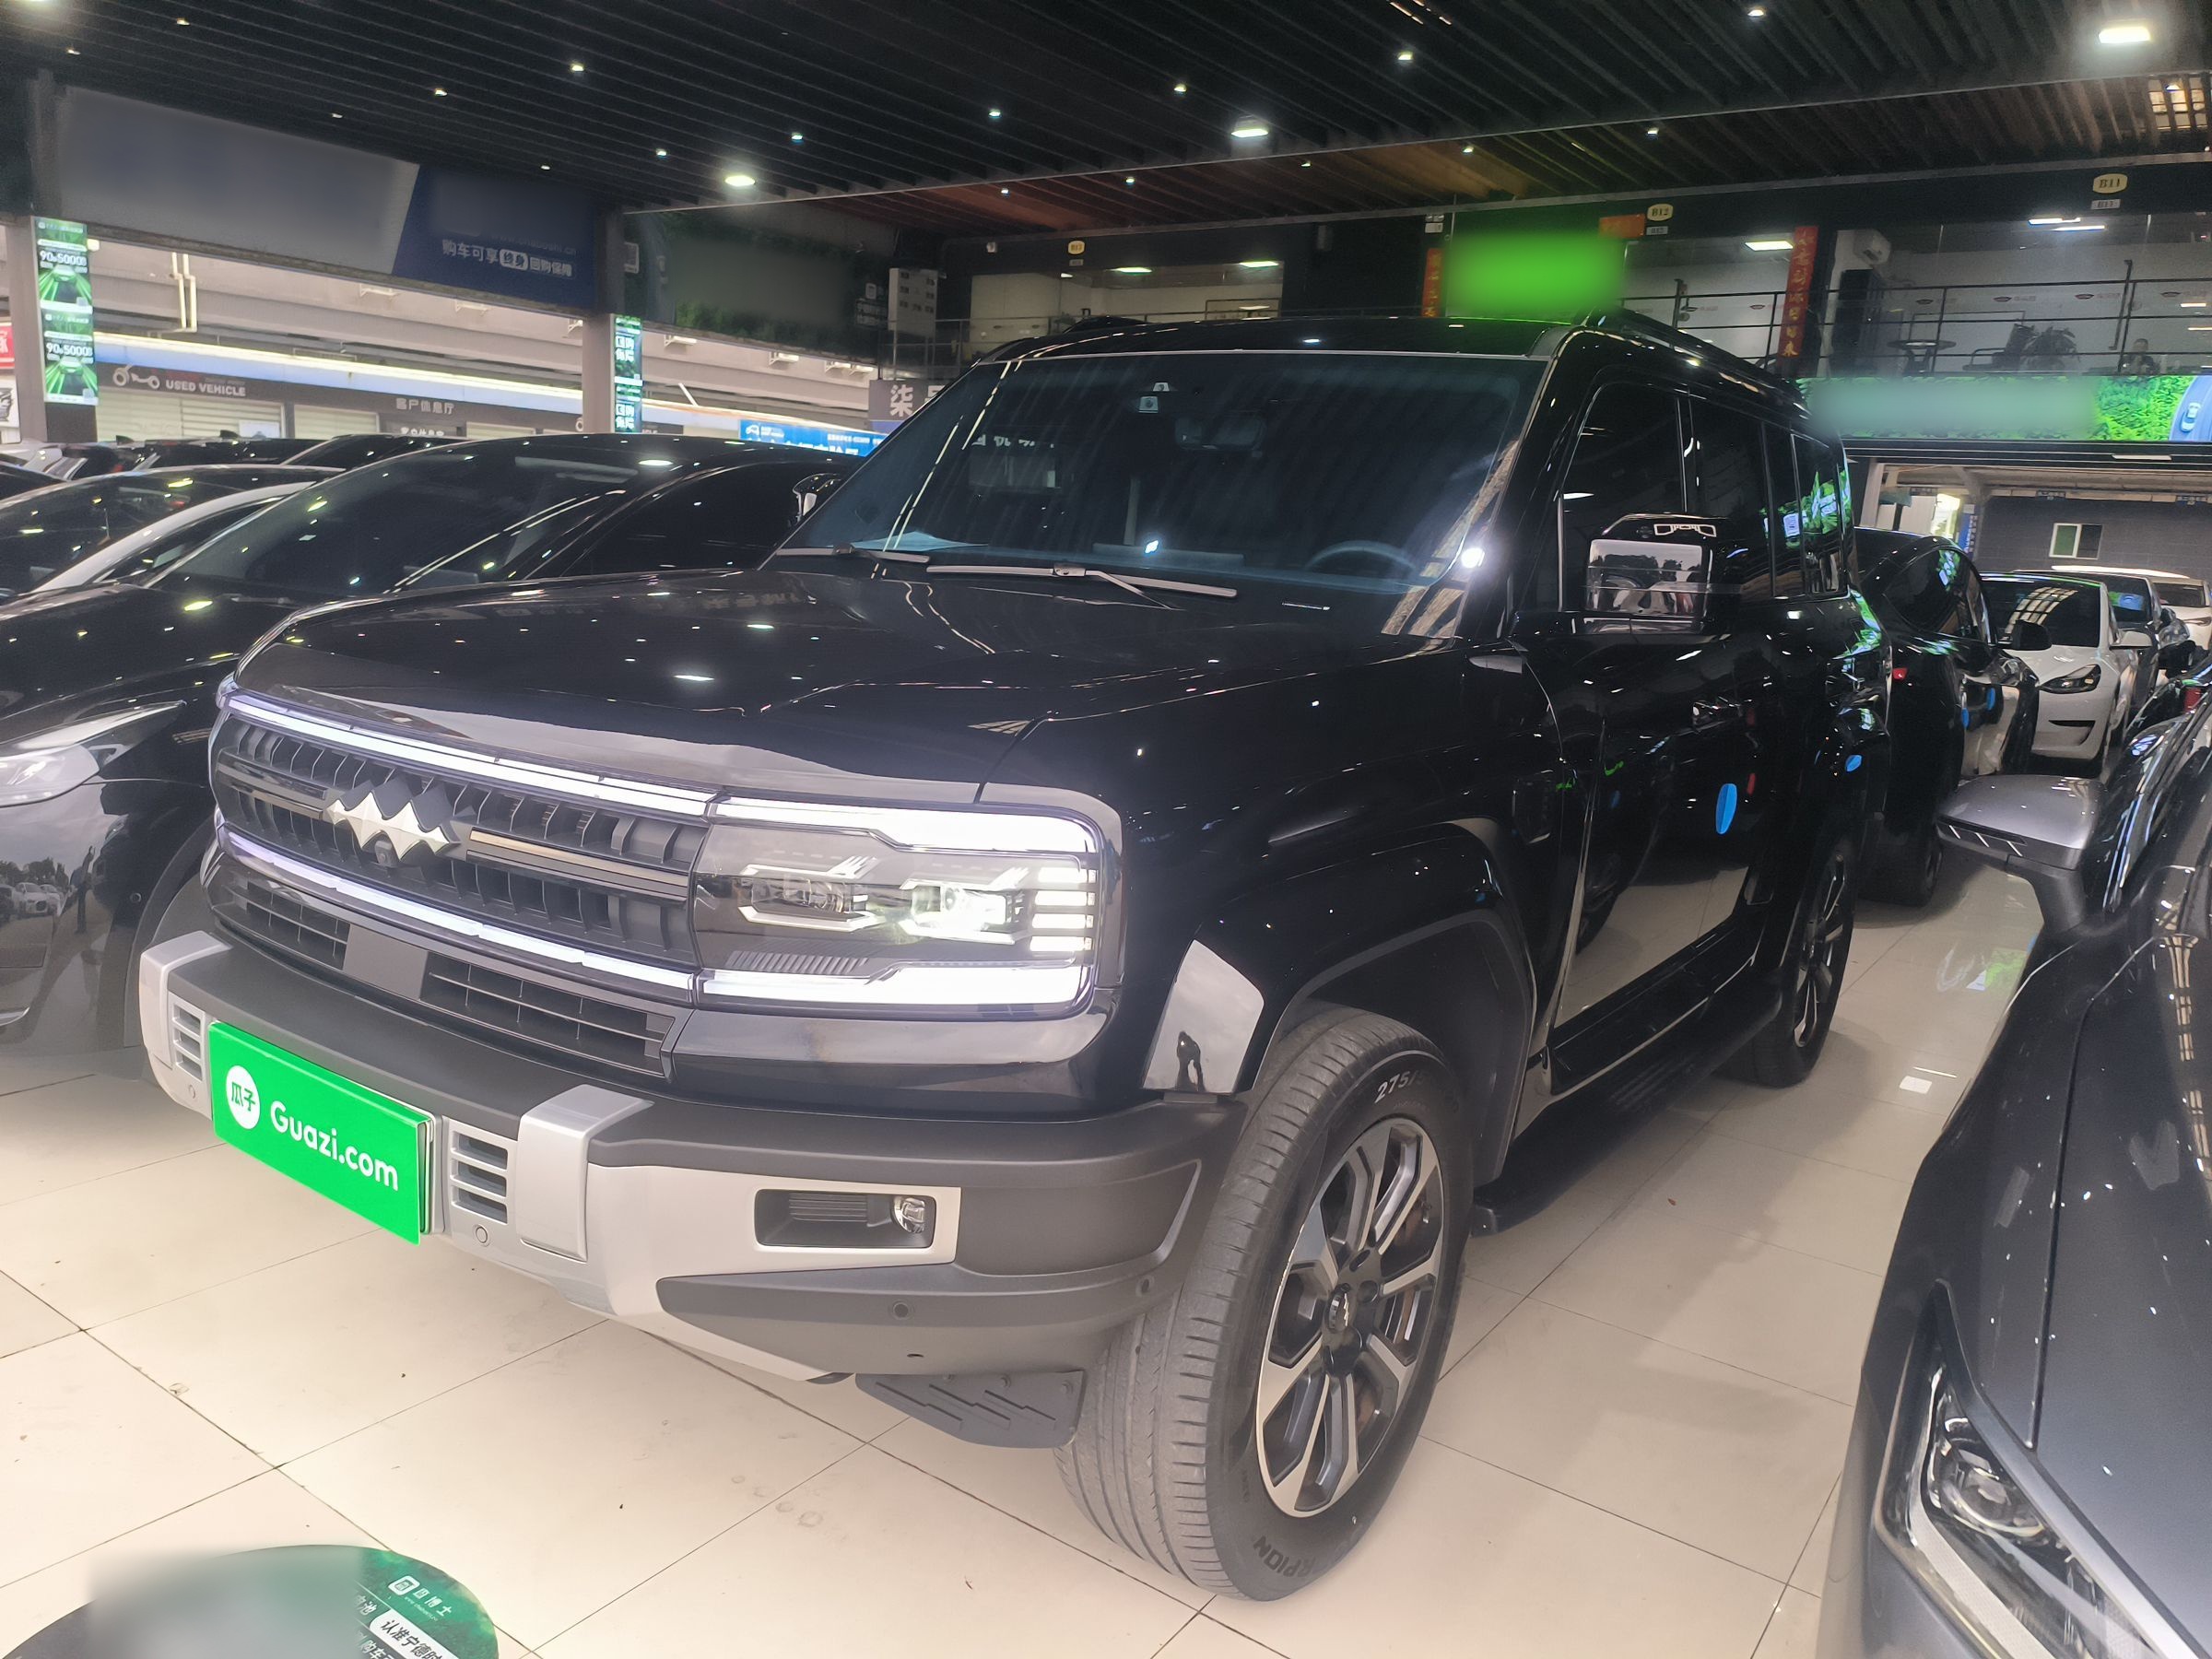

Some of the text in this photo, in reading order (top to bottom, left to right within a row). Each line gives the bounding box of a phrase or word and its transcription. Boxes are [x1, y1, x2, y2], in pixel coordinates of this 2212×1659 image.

[2099, 178, 2121, 189] B11
[1652, 206, 1670, 217] B12
[165, 379, 196, 392] USED
[199, 382, 246, 397] VEHICLE
[231, 1080, 256, 1112] 瓜子
[270, 1100, 399, 1192] Guazi.com
